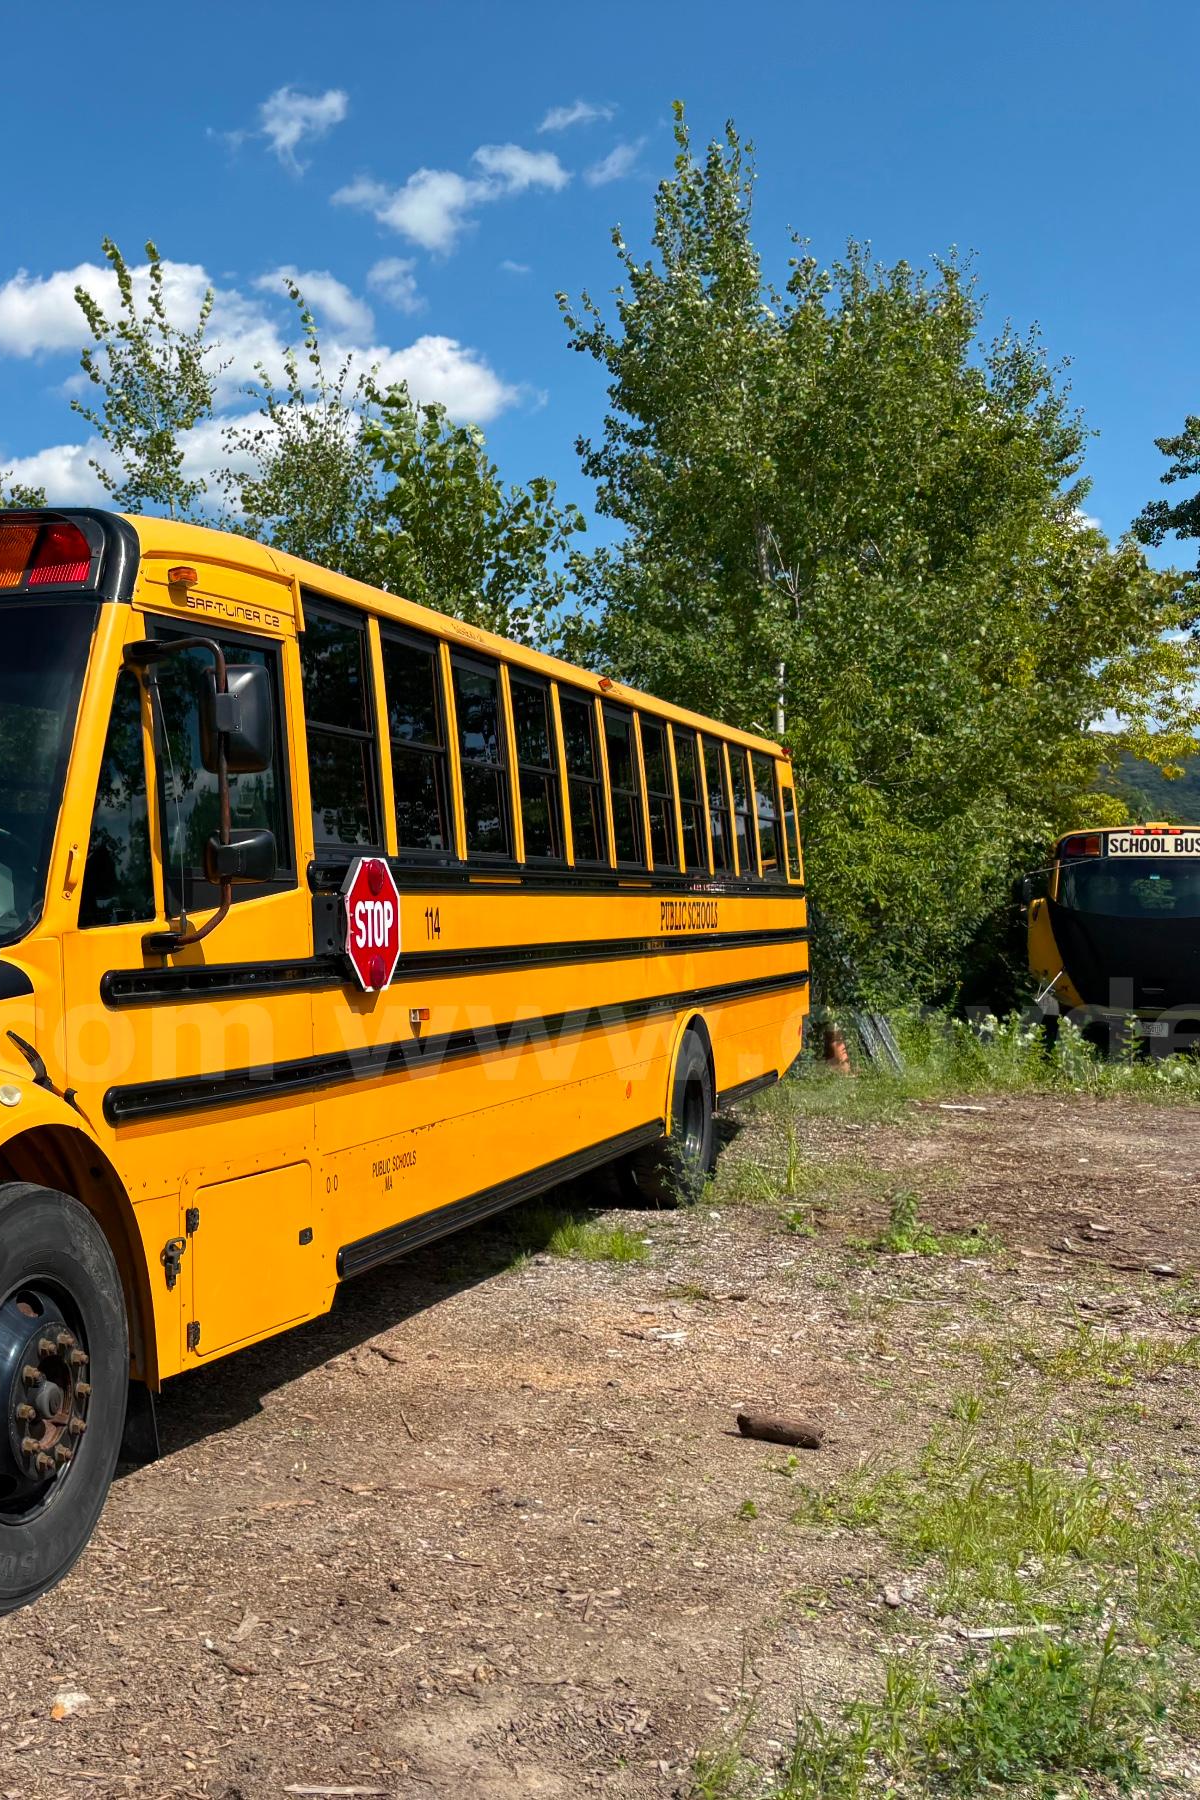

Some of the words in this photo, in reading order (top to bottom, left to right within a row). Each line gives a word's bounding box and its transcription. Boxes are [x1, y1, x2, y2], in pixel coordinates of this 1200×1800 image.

[264, 614, 280, 627] C2
[1110, 838, 1169, 853] SCHOOL
[354, 901, 394, 948] STOP
[424, 907, 440, 940] 114
[660, 901, 687, 931] PUBLIC
[688, 901, 718, 930] SCHOOLS
[372, 1158, 391, 1178] PUBLIC
[392, 1150, 416, 1172] SCHOOLS
[384, 1176, 393, 1192] MA
